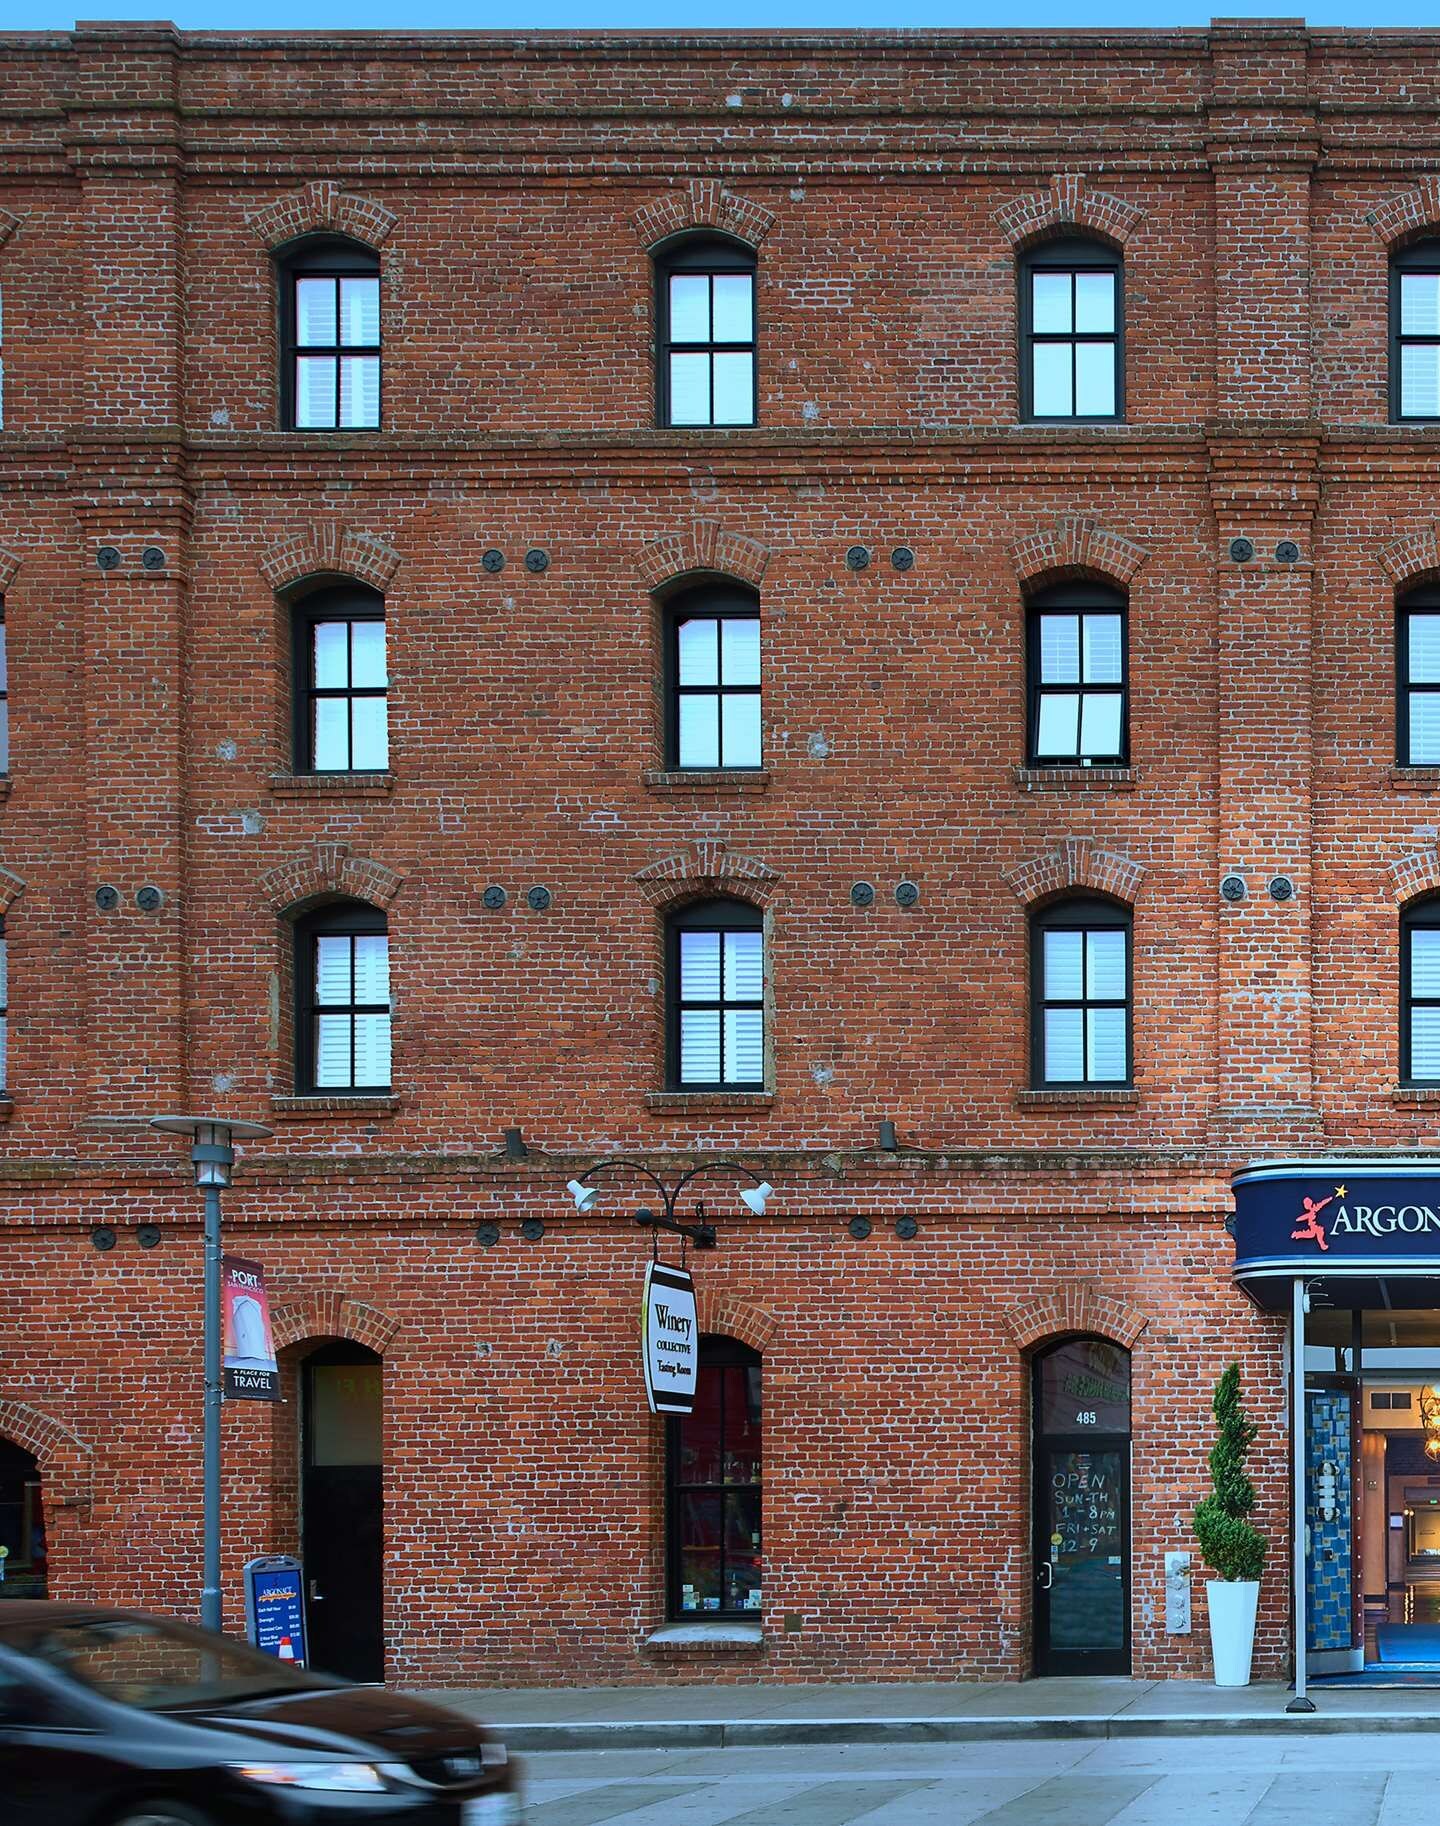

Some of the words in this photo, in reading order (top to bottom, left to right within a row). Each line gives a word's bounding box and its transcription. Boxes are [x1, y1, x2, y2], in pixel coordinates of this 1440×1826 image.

[231, 1269, 258, 1288] PORT
[654, 1303, 692, 1341] Winery
[656, 1339, 692, 1354] COLLECTIVE
[657, 1359, 676, 1378] Tasting
[676, 1362, 692, 1376] Room
[233, 1375, 272, 1390] TRAVEL
[1076, 1411, 1097, 1425] 485
[1052, 1473, 1105, 1489] OPEN
